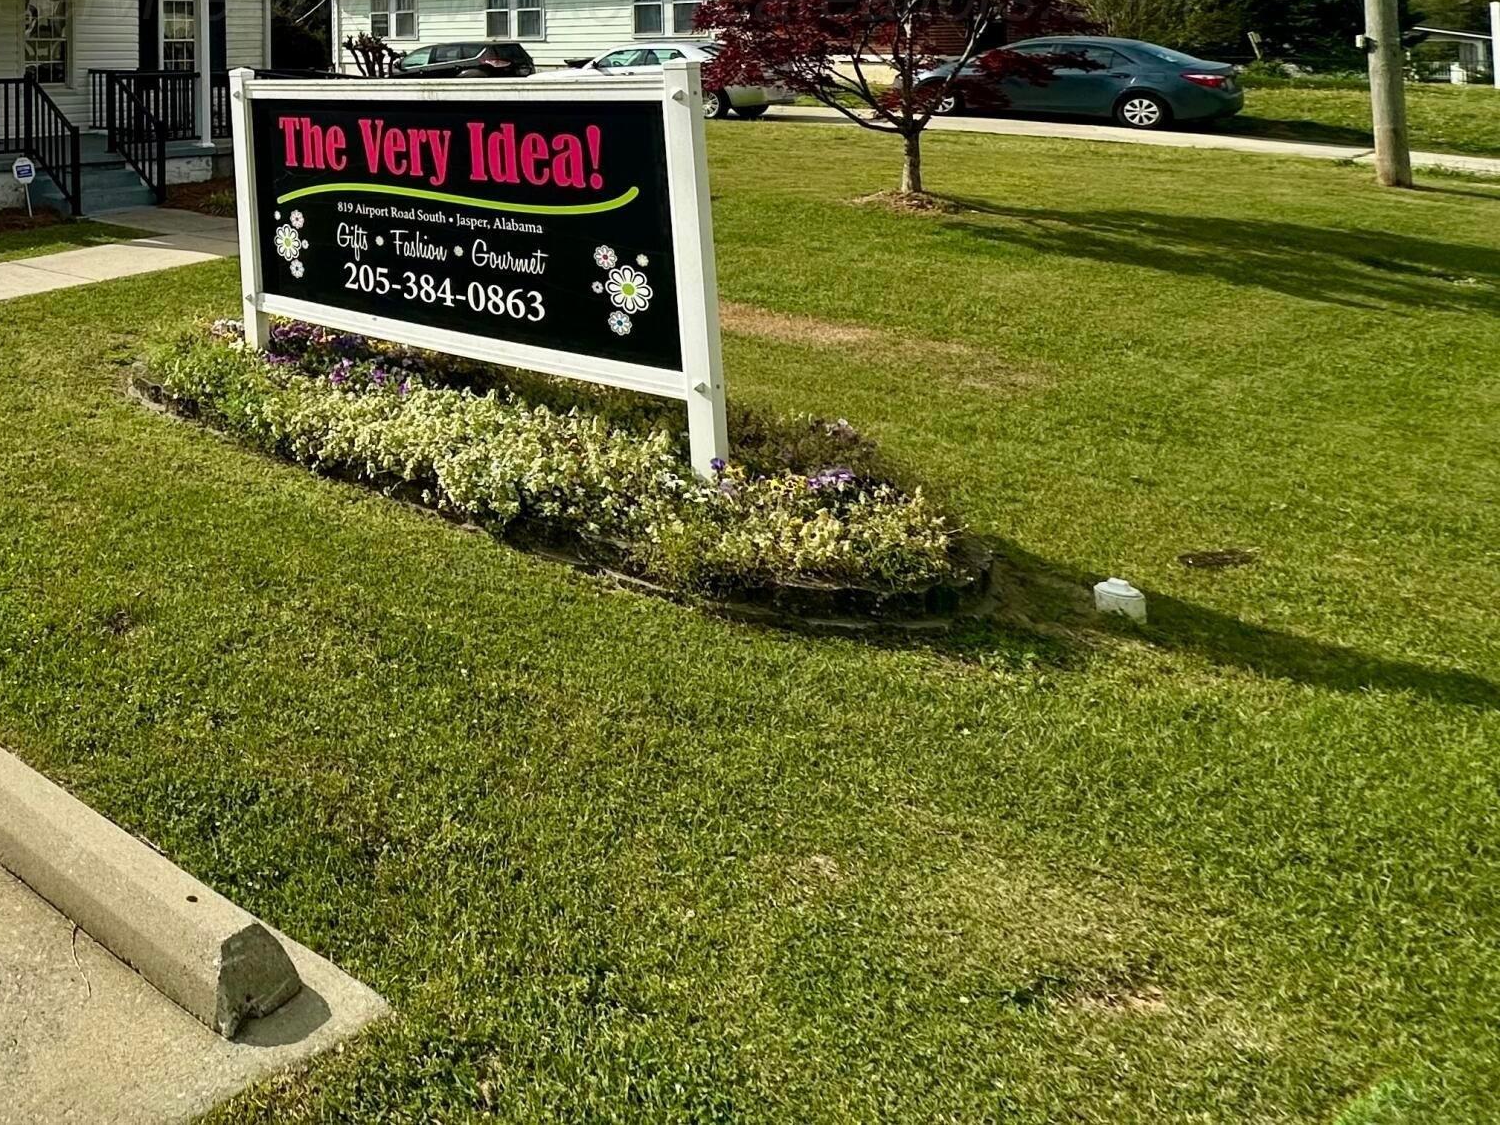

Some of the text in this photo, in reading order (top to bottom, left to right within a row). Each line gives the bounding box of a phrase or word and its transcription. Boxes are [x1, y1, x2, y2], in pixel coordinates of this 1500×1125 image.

[279, 117, 602, 189] The Very Idea!
[337, 202, 542, 233] 819 Airport Road South Jasper, Alabama
[336, 222, 548, 274] Gifts Fashion Gourmet
[343, 262, 546, 322] 205-384-0863
